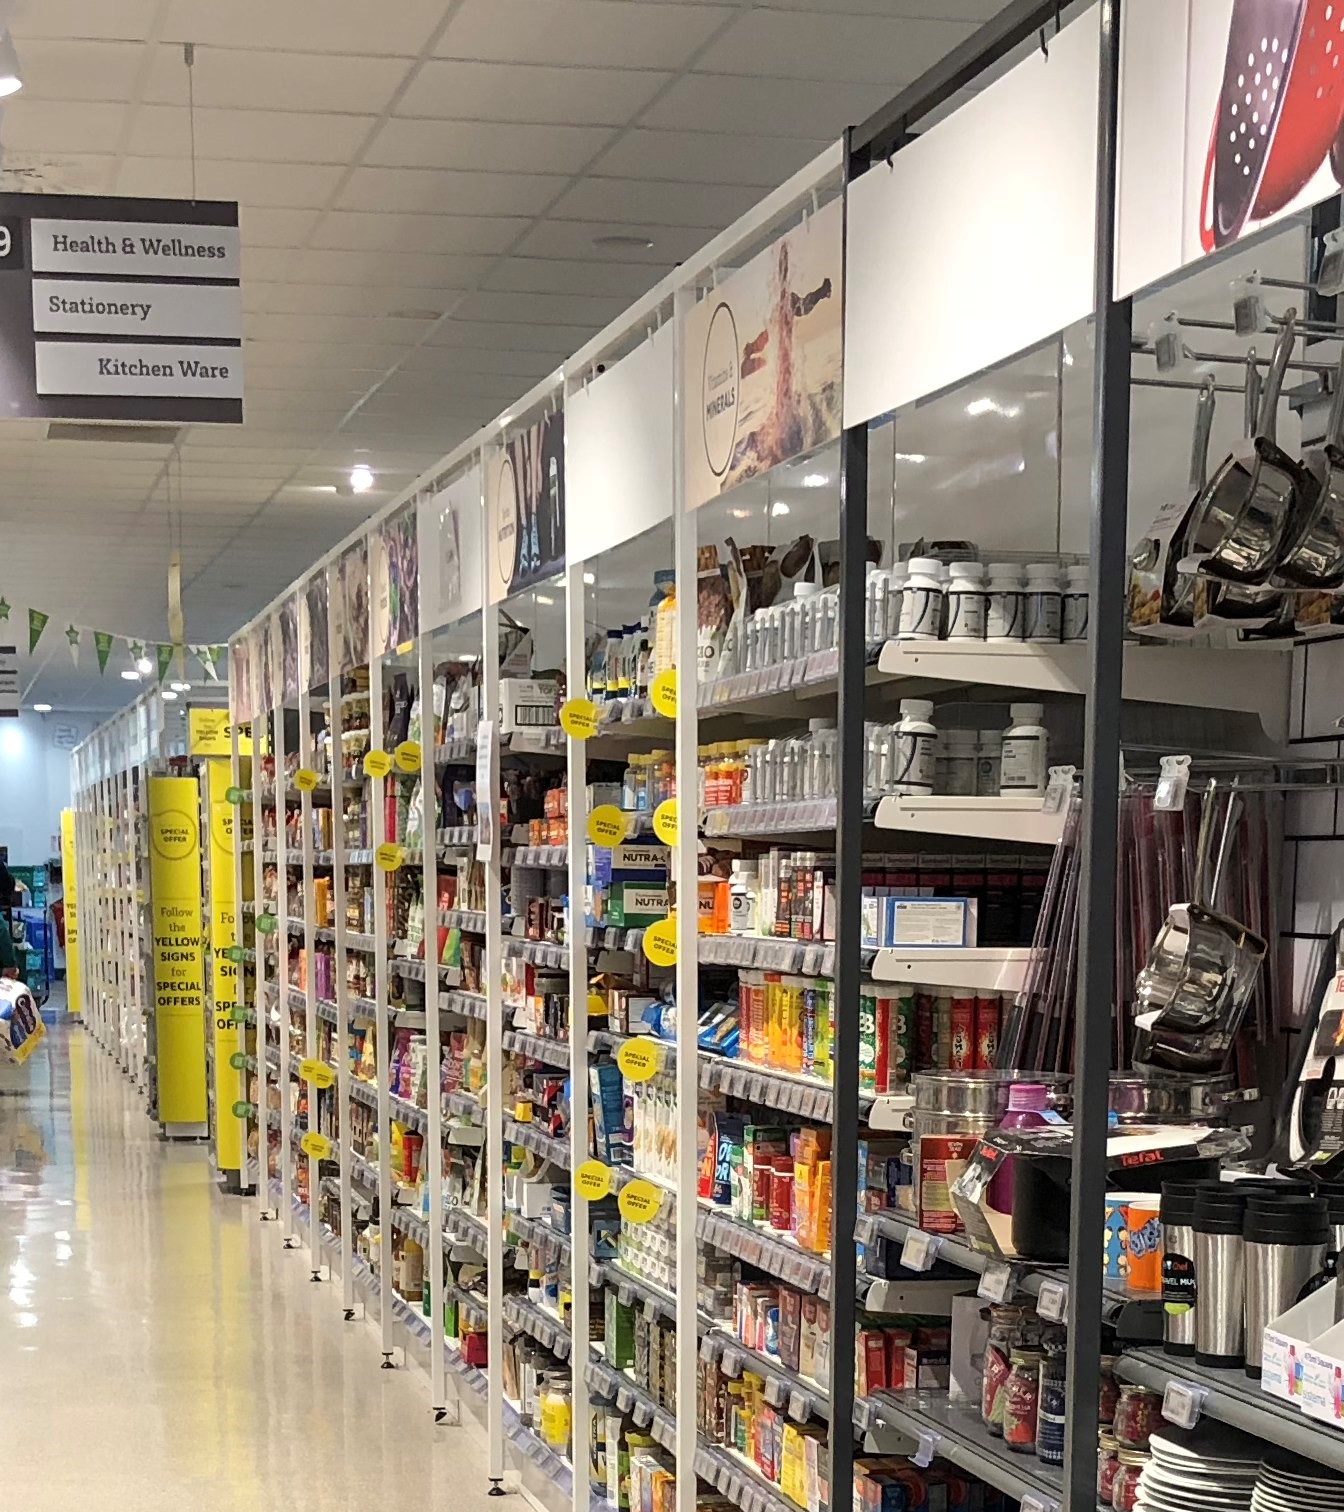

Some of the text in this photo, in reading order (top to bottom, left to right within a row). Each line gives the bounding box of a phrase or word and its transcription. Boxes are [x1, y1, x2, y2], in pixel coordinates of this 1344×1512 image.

[52, 234, 226, 259] Health & Wellness
[49, 296, 153, 322] Stationery
[98, 358, 229, 379] Kitchen Ware
[706, 386, 735, 420] MINERALS
[570, 719, 590, 729] OFFER
[596, 820, 620, 831] SPECIAL
[160, 827, 189, 836] SPECIAL
[597, 827, 618, 836] OFFER
[163, 835, 187, 843] OFFER
[160, 907, 193, 918] Follow
[169, 922, 186, 932] the
[154, 937, 200, 947] YELLOW
[653, 943, 675, 955] OFFER
[160, 952, 196, 962] SIGNS
[171, 967, 186, 977] for
[156, 981, 201, 992] SPECIAL
[158, 996, 201, 1006] OFFERS
[624, 1051, 650, 1063] SPECIAL
[625, 1058, 647, 1068] OFFER
[1120, 1150, 1164, 1167] Tefal
[581, 1172, 604, 1183] SPECIAL
[582, 1179, 601, 1188] OFFER
[626, 1193, 651, 1205] SPECIAL
[626, 1200, 648, 1210] OFFER
